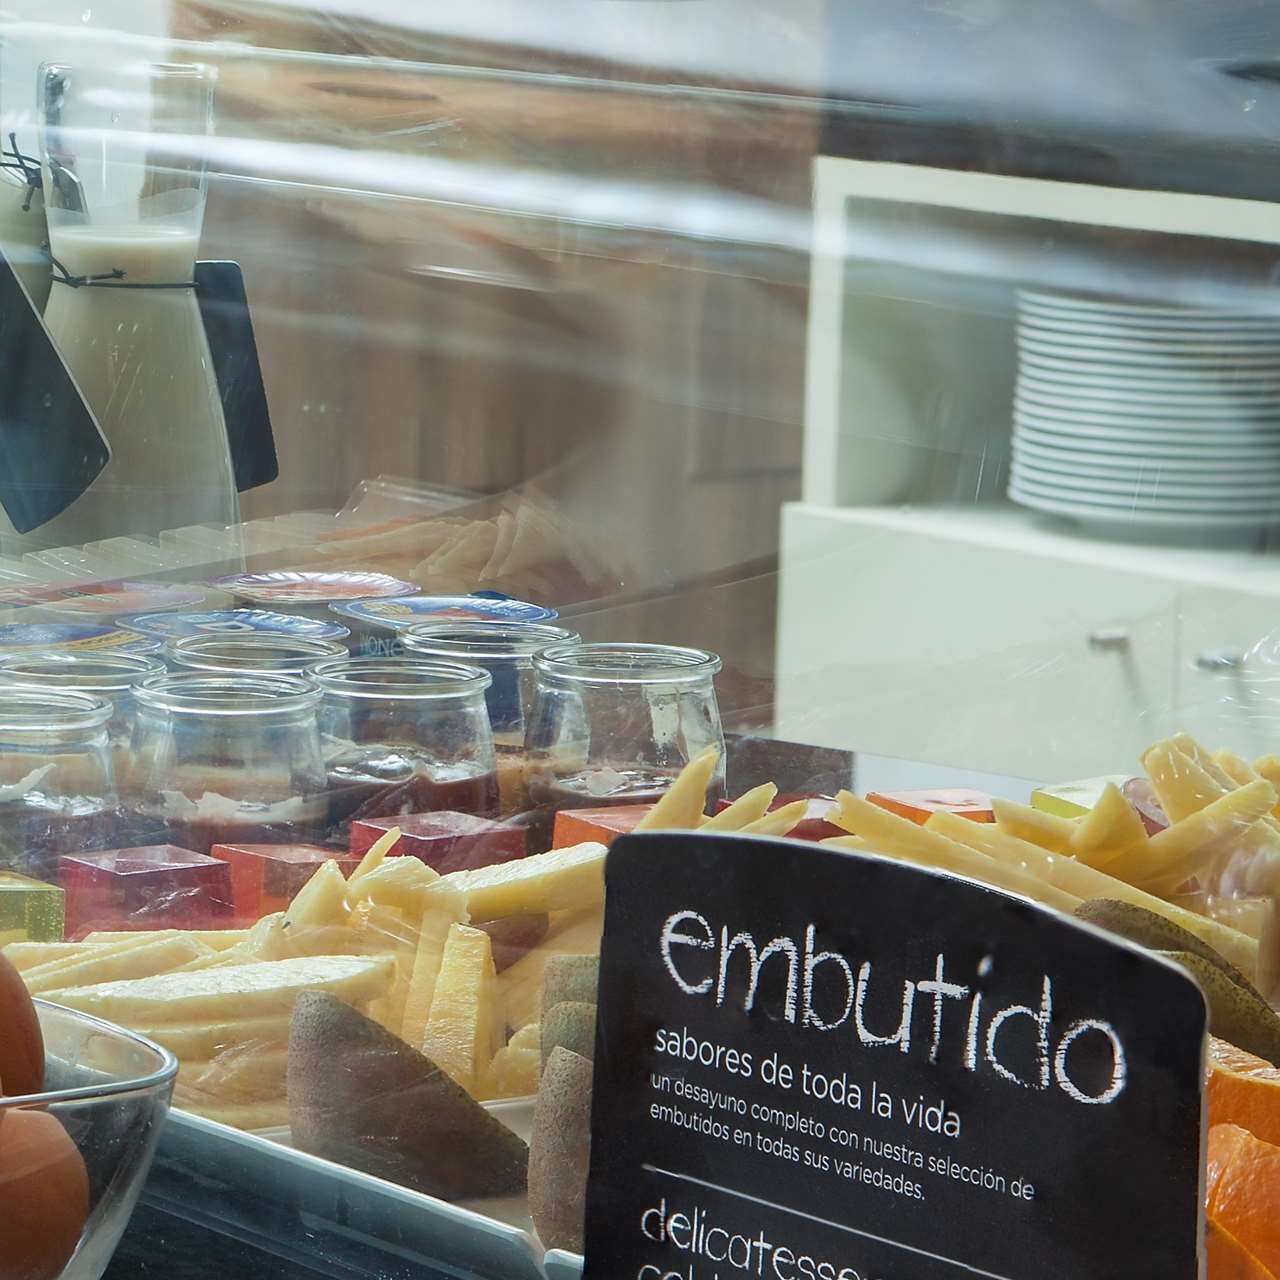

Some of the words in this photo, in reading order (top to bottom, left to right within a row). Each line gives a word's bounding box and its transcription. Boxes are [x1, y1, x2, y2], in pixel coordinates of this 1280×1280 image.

[659, 909, 1128, 1105] embutido
[650, 1072, 671, 1093] un
[673, 1076, 748, 1116] desayuno
[750, 1099, 826, 1139] completo
[829, 1124, 860, 1149] con
[863, 1132, 924, 1169] nuestra
[927, 1154, 1007, 1194] selección
[1010, 1175, 1035, 1201] de
[655, 1026, 753, 1079] sabores
[760, 1053, 794, 1090] de
[801, 1063, 863, 1111] toda
[871, 1080, 893, 1120] la
[901, 1095, 962, 1139] vida
[650, 1103, 730, 1141] embutidos
[733, 1129, 753, 1148] en
[756, 1132, 801, 1163] todas
[803, 1150, 831, 1173] sus
[833, 1156, 926, 1201] variedades.
